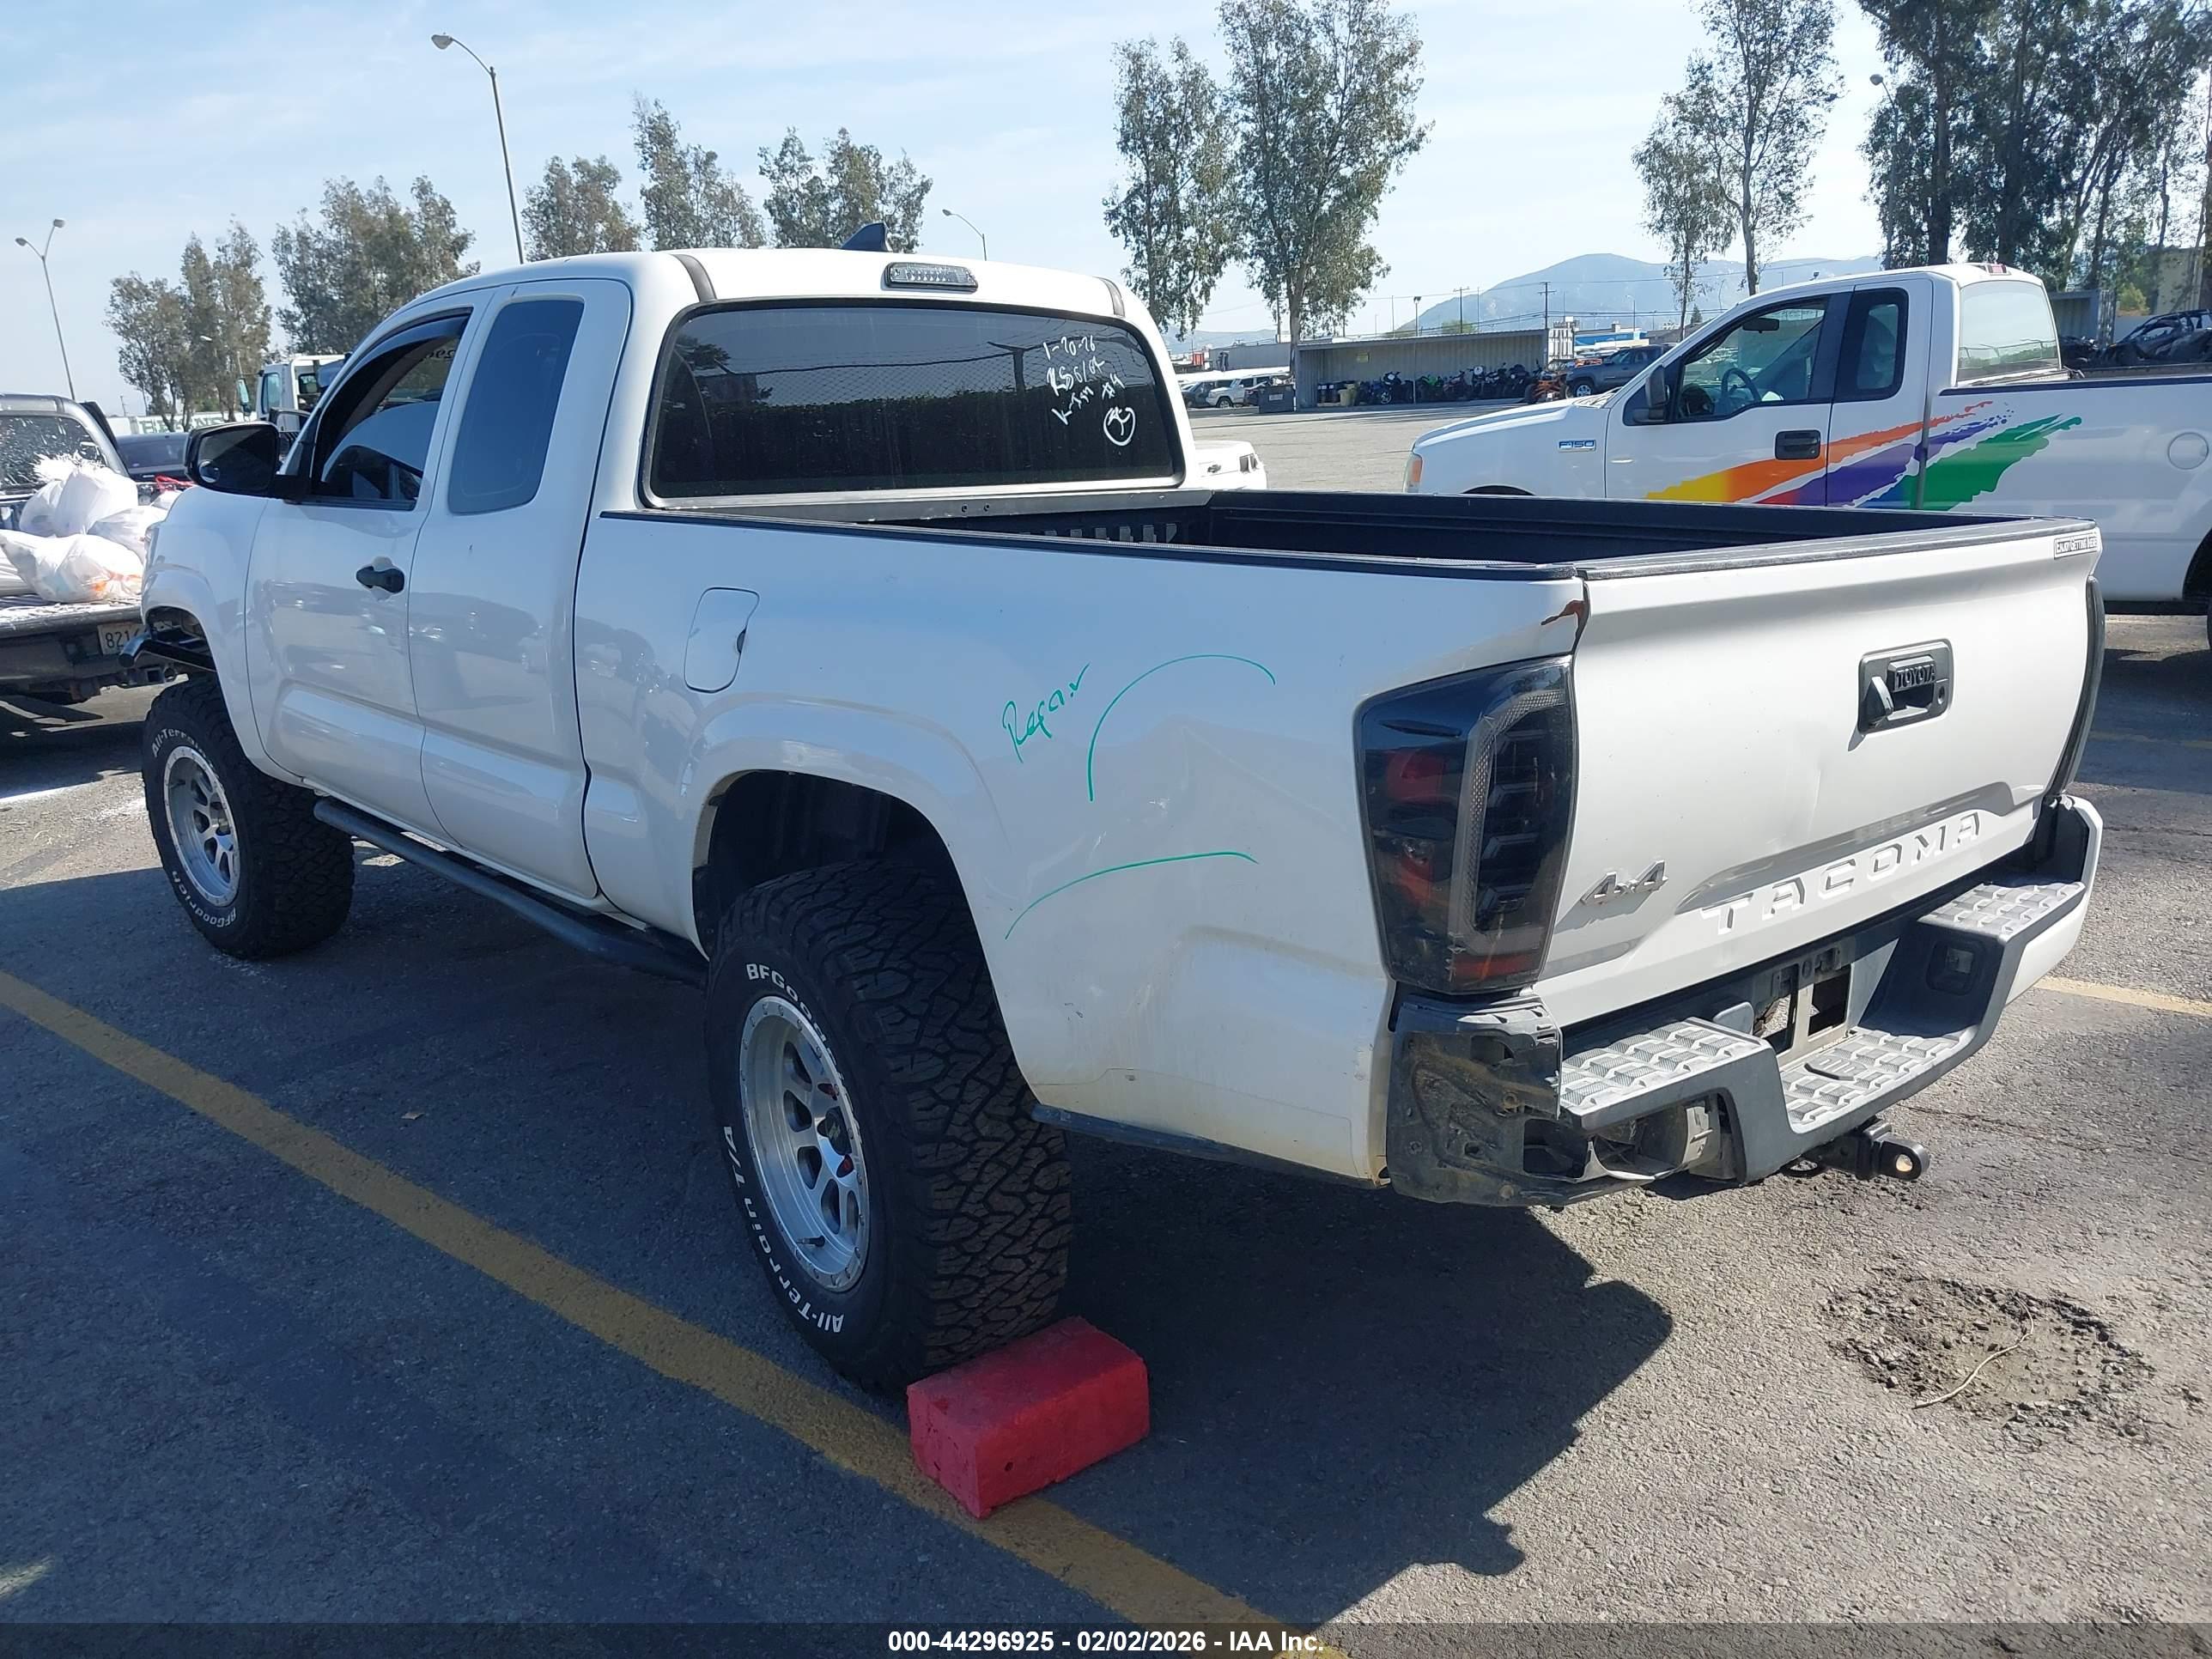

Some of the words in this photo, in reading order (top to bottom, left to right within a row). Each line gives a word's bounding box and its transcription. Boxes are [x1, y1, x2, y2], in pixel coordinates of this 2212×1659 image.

[1895, 664, 1936, 690] TOYOTA
[1699, 811, 1981, 935] TACOMA
[724, 1127, 745, 1188] T/A
[744, 1198, 845, 1333] All-Terrain
